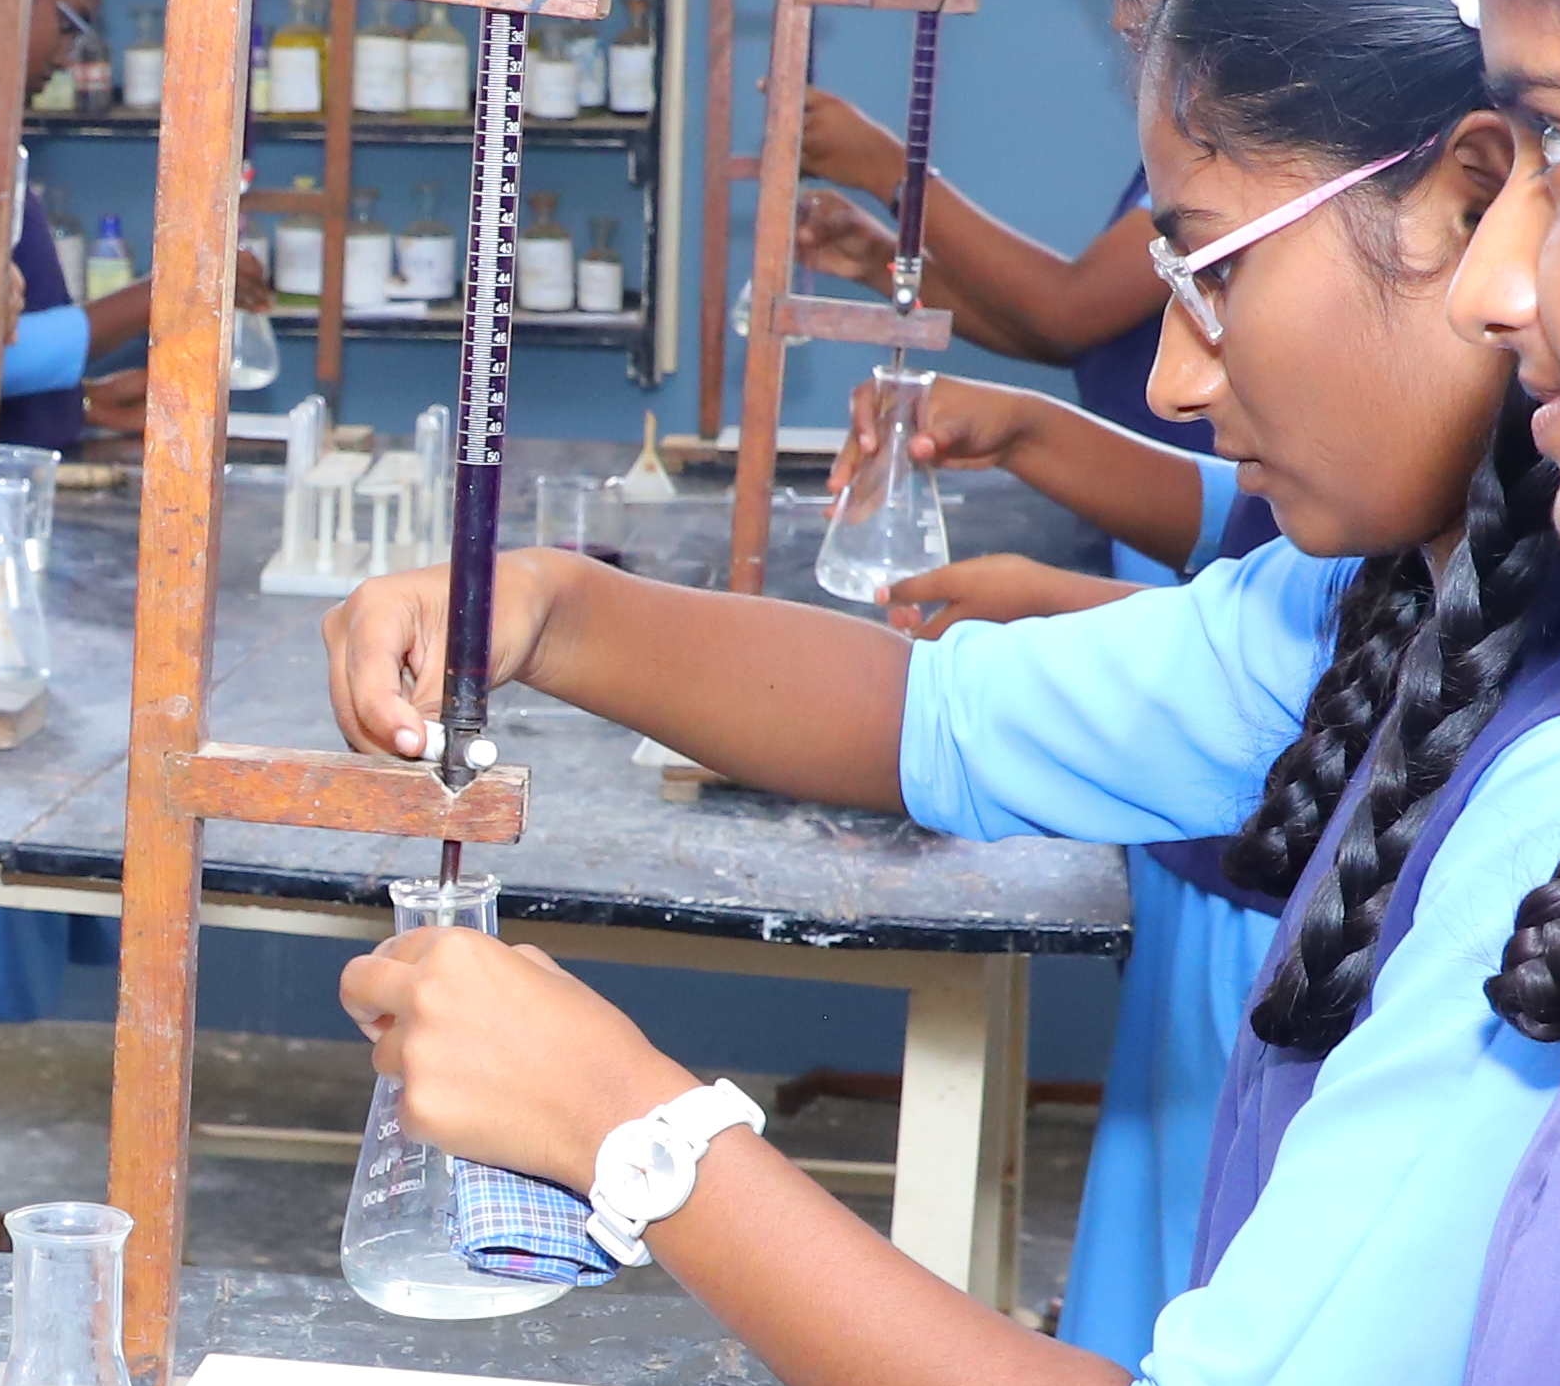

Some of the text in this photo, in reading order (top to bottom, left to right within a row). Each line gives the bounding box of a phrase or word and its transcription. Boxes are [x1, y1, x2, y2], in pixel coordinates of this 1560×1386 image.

[511, 30, 525, 43] 36
[509, 60, 523, 73] 37
[507, 91, 521, 103] 38
[505, 121, 520, 134] 39
[504, 151, 518, 164] 40
[502, 182, 515, 194] 41
[500, 212, 514, 224] 42
[499, 242, 513, 254] 43
[497, 272, 511, 284] 44
[495, 302, 509, 314] 45
[493, 332, 507, 344] 46
[491, 362, 506, 374] 47
[490, 391, 504, 404] 48
[488, 421, 502, 433] 49
[486, 451, 500, 463] 50
